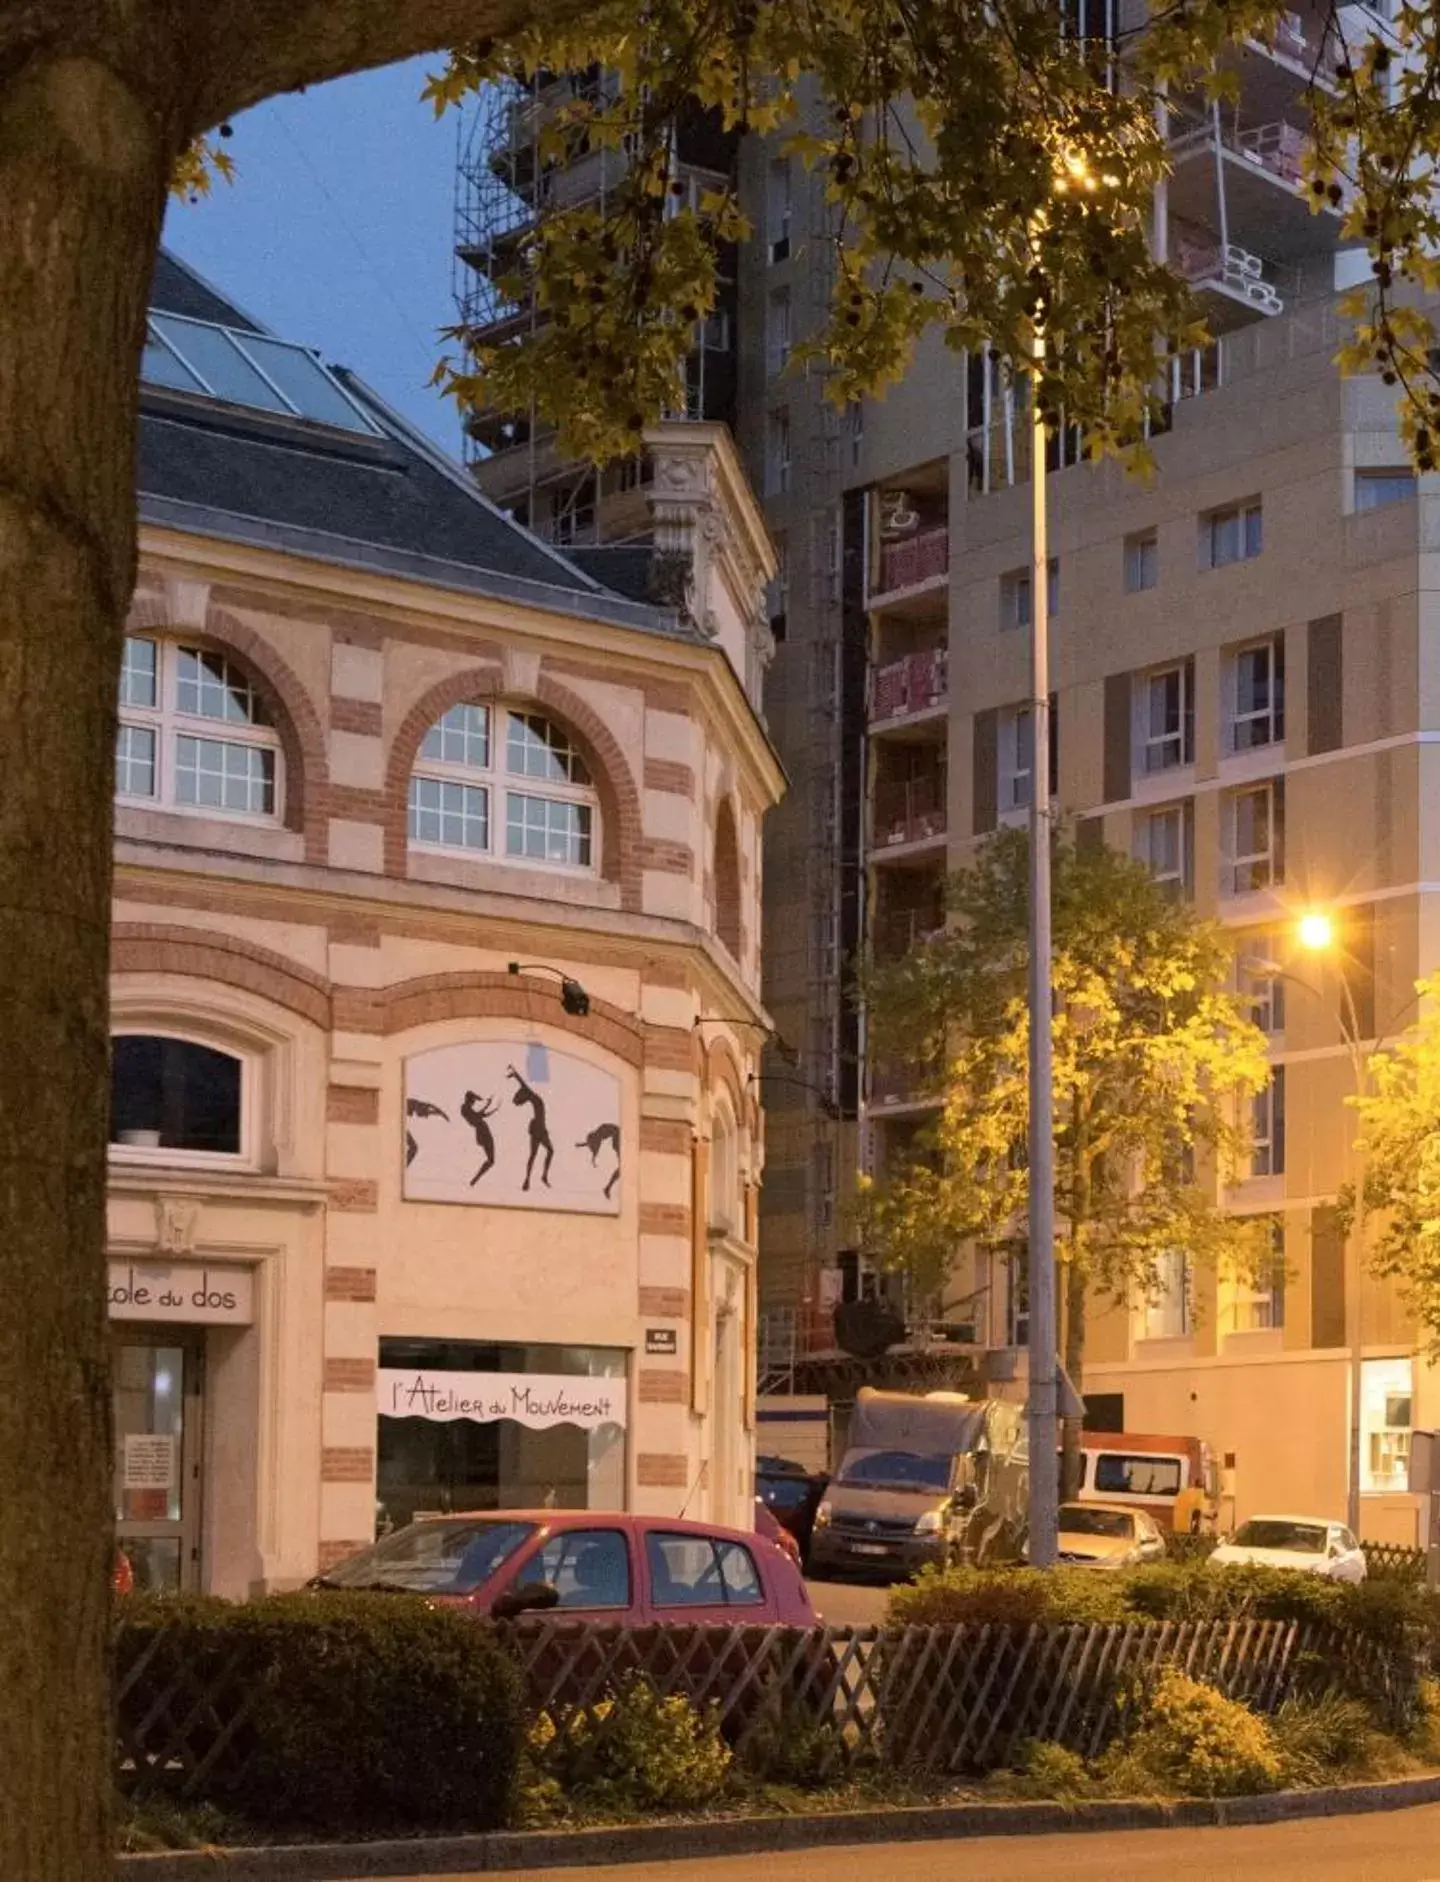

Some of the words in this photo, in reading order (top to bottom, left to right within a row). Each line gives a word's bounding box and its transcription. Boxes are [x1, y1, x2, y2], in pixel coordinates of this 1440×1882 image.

[158, 1290, 184, 1307] du
[191, 1270, 237, 1310] dos
[489, 1399, 507, 1414] du
[511, 1384, 611, 1417] Mouvement
